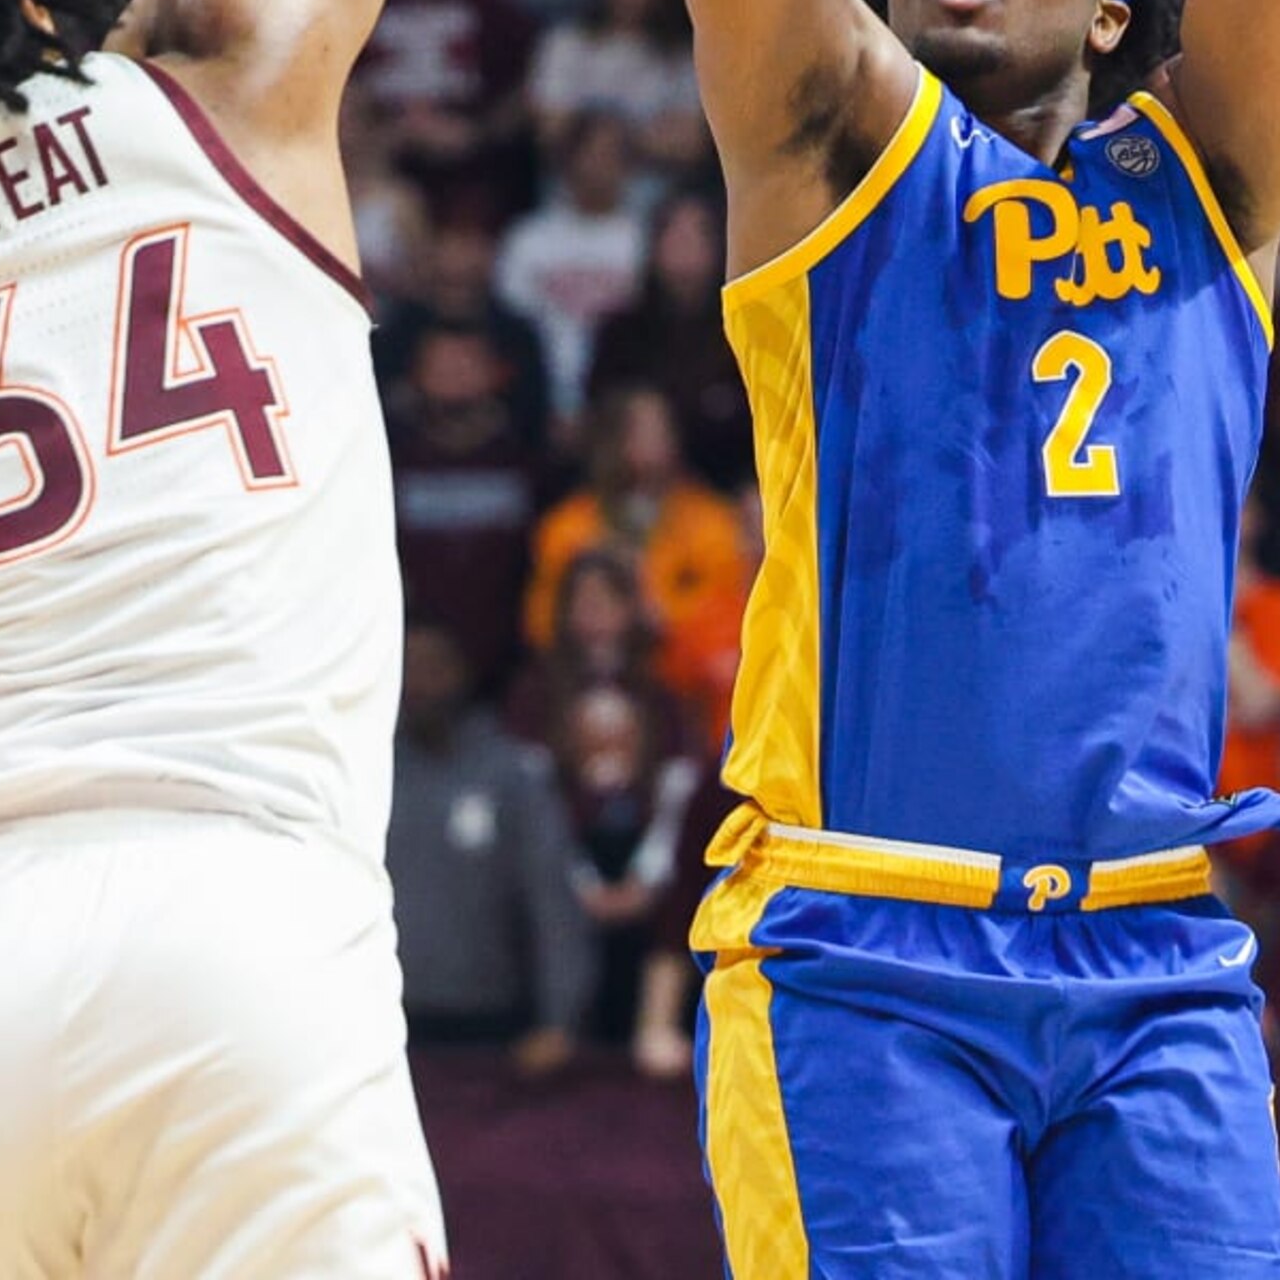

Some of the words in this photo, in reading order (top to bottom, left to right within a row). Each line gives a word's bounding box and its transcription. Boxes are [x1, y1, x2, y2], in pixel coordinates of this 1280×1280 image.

[963, 177, 1161, 307] Ptt
[1032, 329, 1120, 498] 2
[1021, 863, 1072, 912] P
